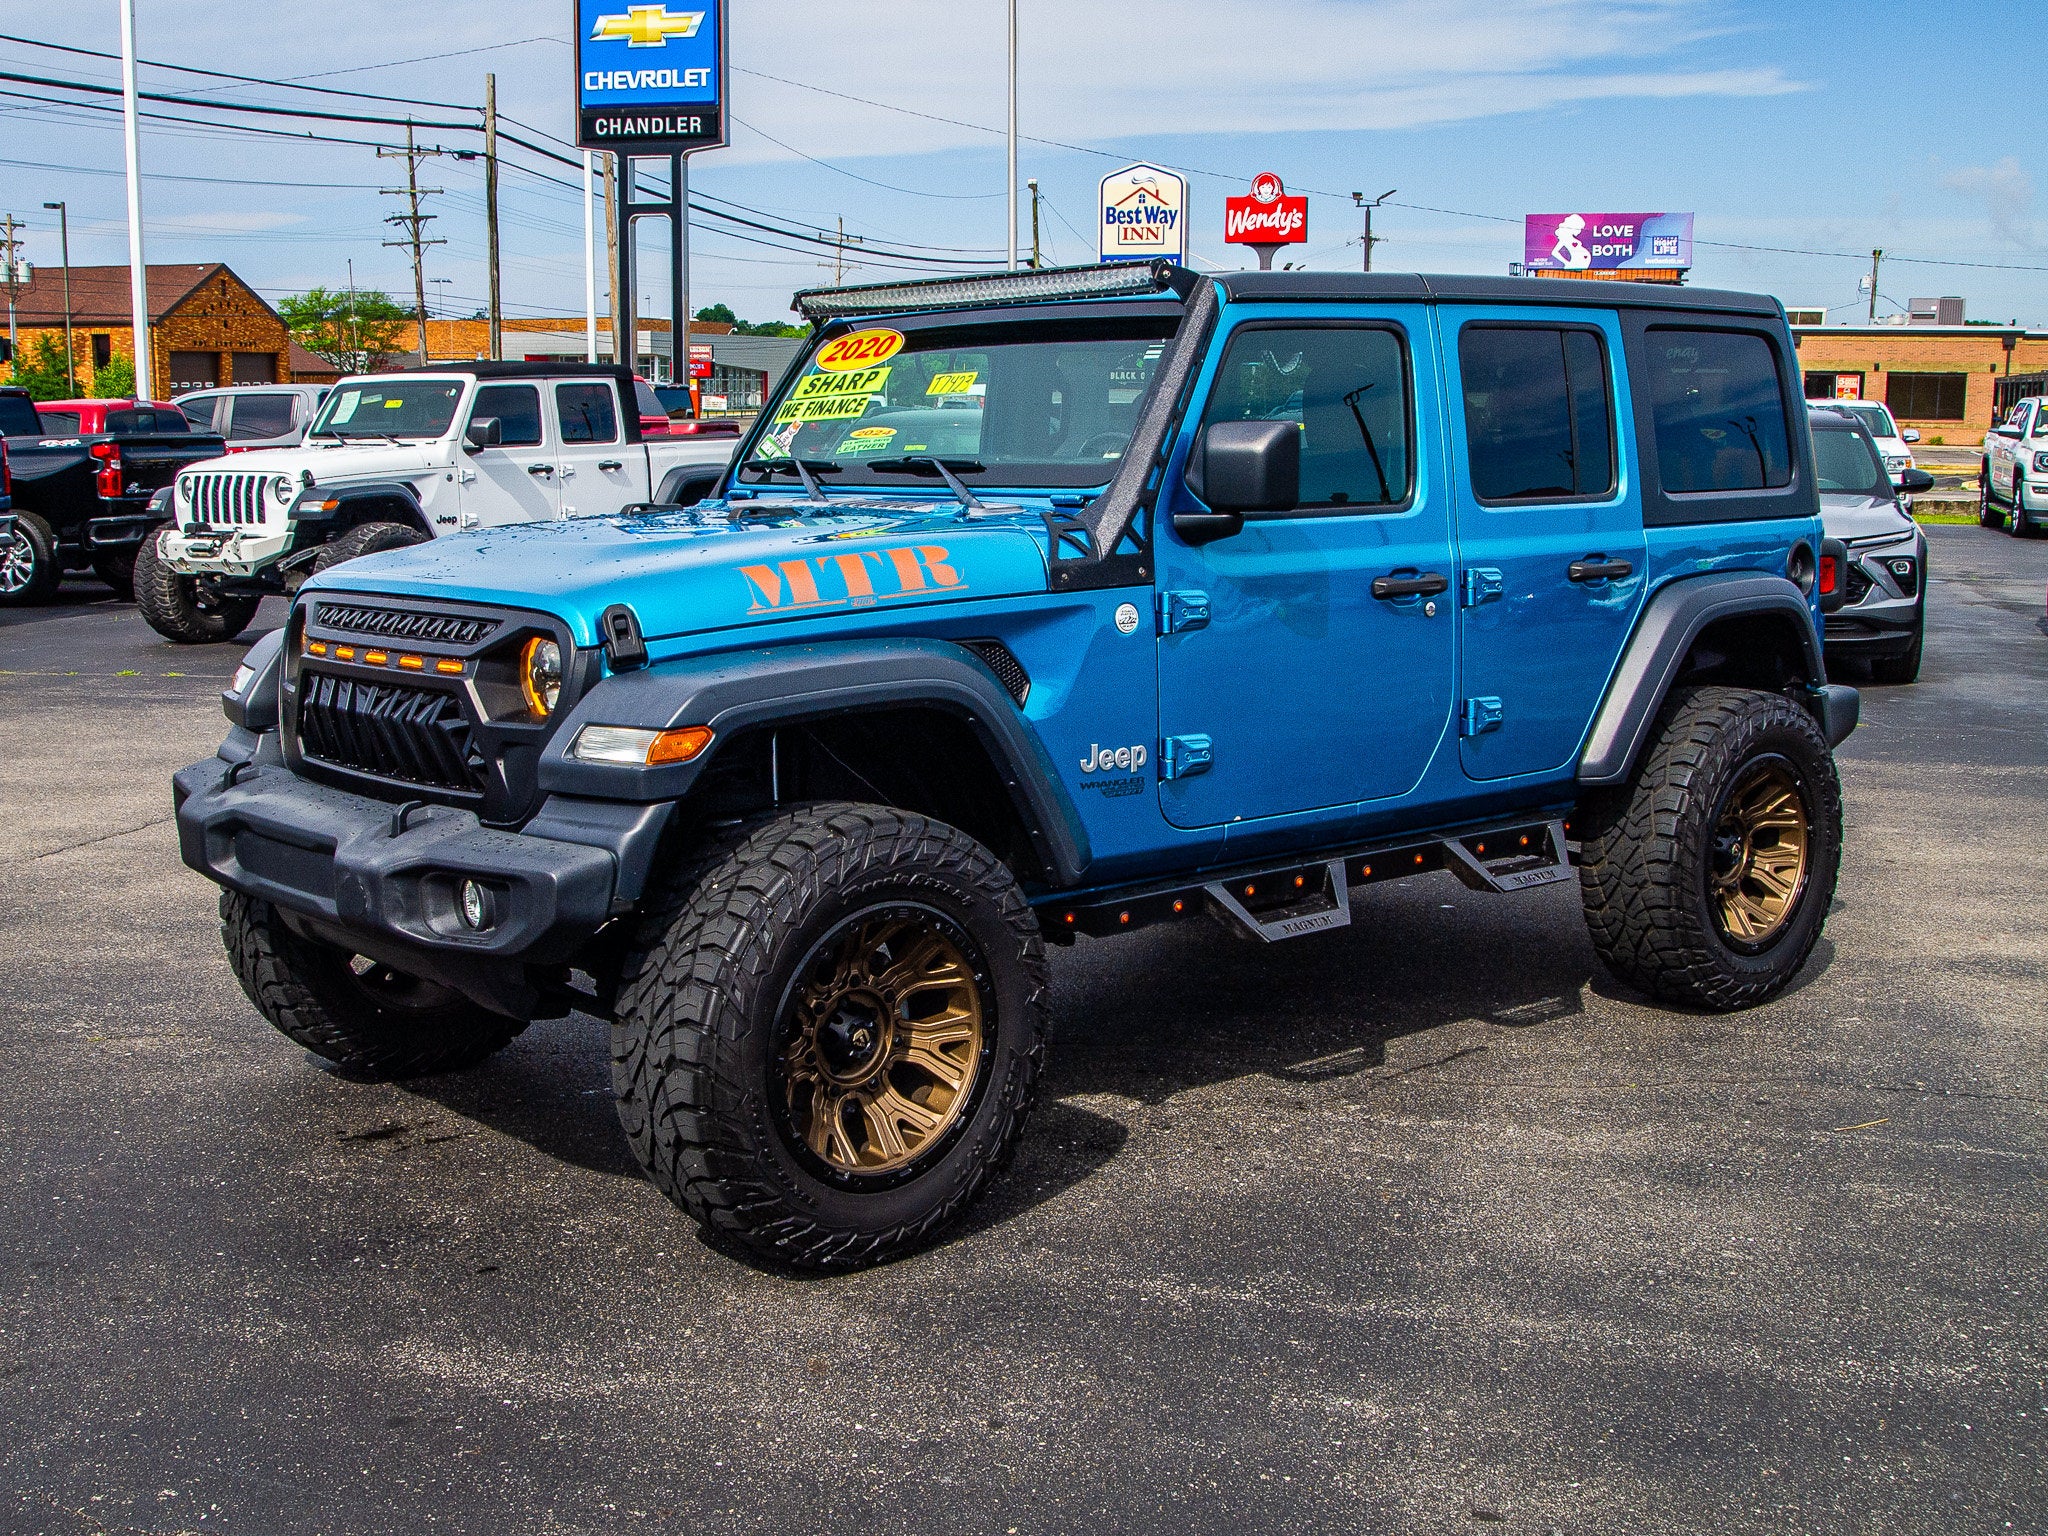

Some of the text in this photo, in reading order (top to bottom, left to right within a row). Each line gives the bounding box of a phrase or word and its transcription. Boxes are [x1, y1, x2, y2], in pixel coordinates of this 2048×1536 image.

[584, 67, 711, 91] CHEVROLET
[595, 116, 702, 136] CHANDLER
[1106, 206, 1178, 229] Best Way
[1228, 203, 1304, 237] Wendy's
[1122, 226, 1160, 241] INN
[1592, 224, 1634, 237] LOVE
[1592, 244, 1633, 257] BOTH
[1653, 246, 1678, 255] LIFE
[823, 335, 897, 363] 2020
[803, 370, 880, 395] SHARP
[930, 374, 974, 393] T7423
[1110, 371, 1137, 380] BLACK
[779, 397, 868, 419] WE FINANCE
[855, 429, 893, 437] 2024
[436, 514, 458, 526] Jeep
[735, 545, 965, 609] MTR
[1079, 743, 1147, 773] Jeep
[1080, 776, 1145, 792] WRANGLER
[1513, 869, 1557, 886] MAGNUM
[1282, 915, 1334, 935] MAGNUM
